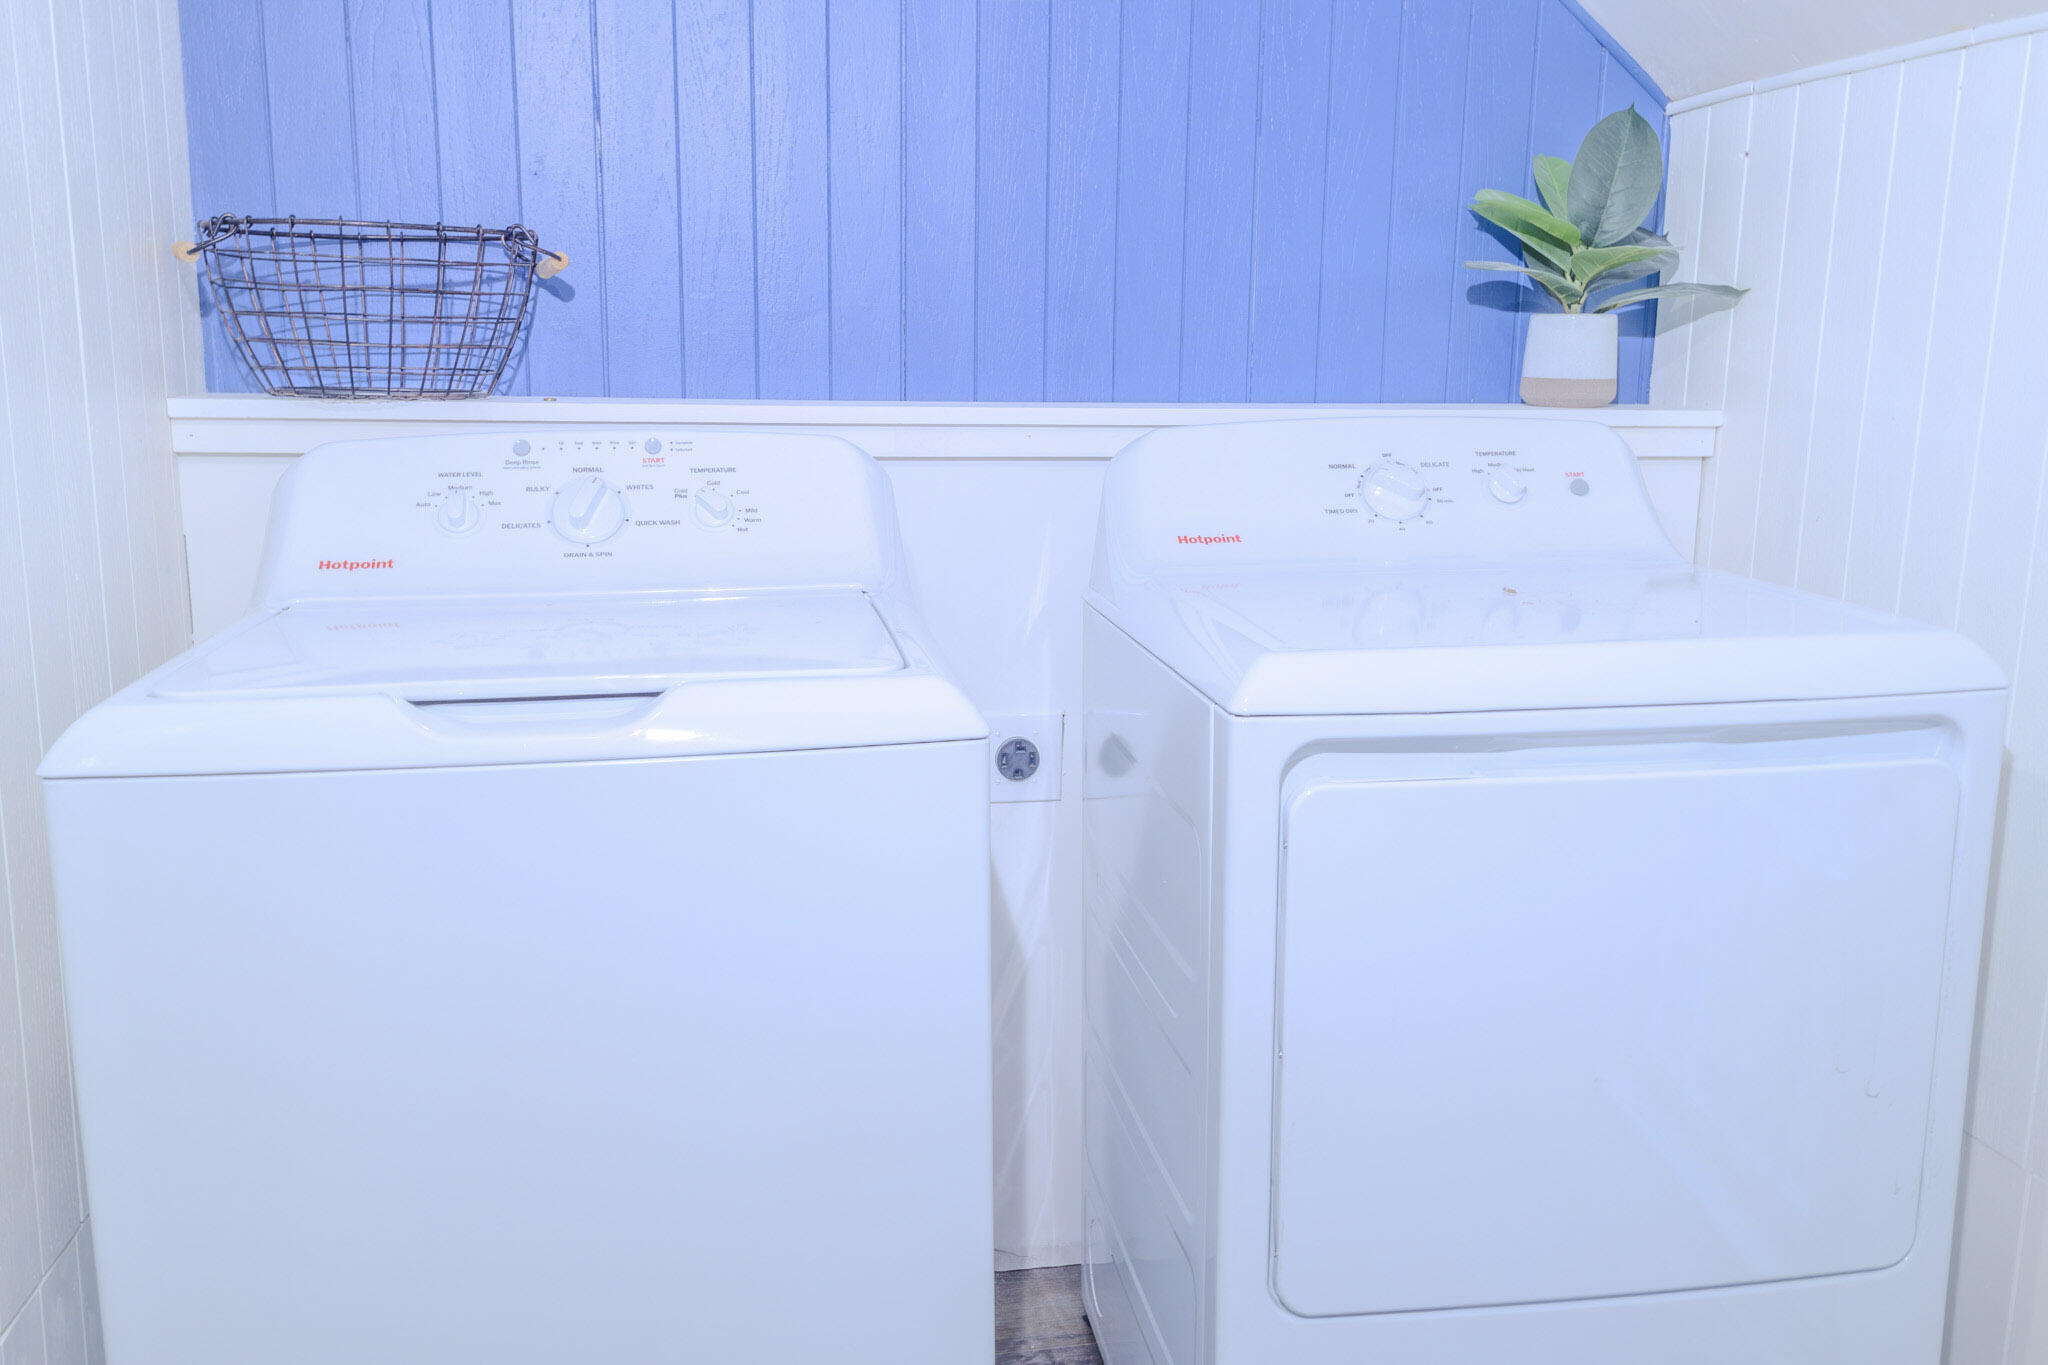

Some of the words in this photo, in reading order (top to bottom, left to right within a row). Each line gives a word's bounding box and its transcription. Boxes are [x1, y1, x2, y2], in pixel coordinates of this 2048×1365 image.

[479, 489, 494, 497] High
[525, 485, 551, 493] BULKY
[501, 522, 542, 530] DELICATES
[635, 519, 658, 527] QUICK
[658, 519, 681, 527] WASH
[1177, 533, 1242, 545] Hotpoint
[563, 551, 587, 559] DRAIN
[318, 558, 394, 571] Hotpoint
